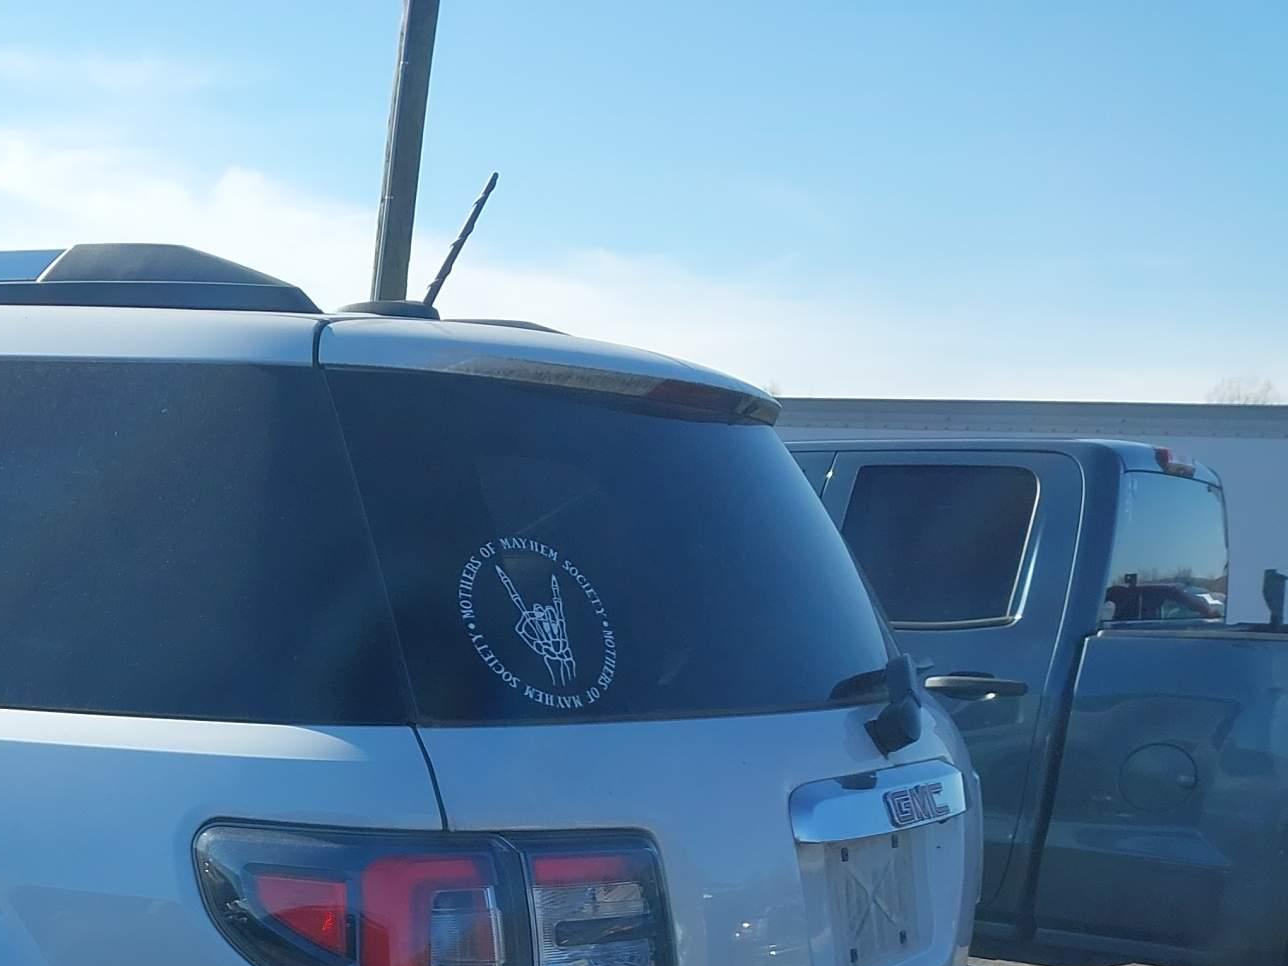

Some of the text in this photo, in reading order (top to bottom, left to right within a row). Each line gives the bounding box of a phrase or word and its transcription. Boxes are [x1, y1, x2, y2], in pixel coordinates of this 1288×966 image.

[458, 536, 608, 620] MOTHERS OF MAYHEM SOCIETY
[468, 629, 617, 709] MOTHERS OF MAYHEM SOCIETY
[884, 782, 951, 828] GMC
